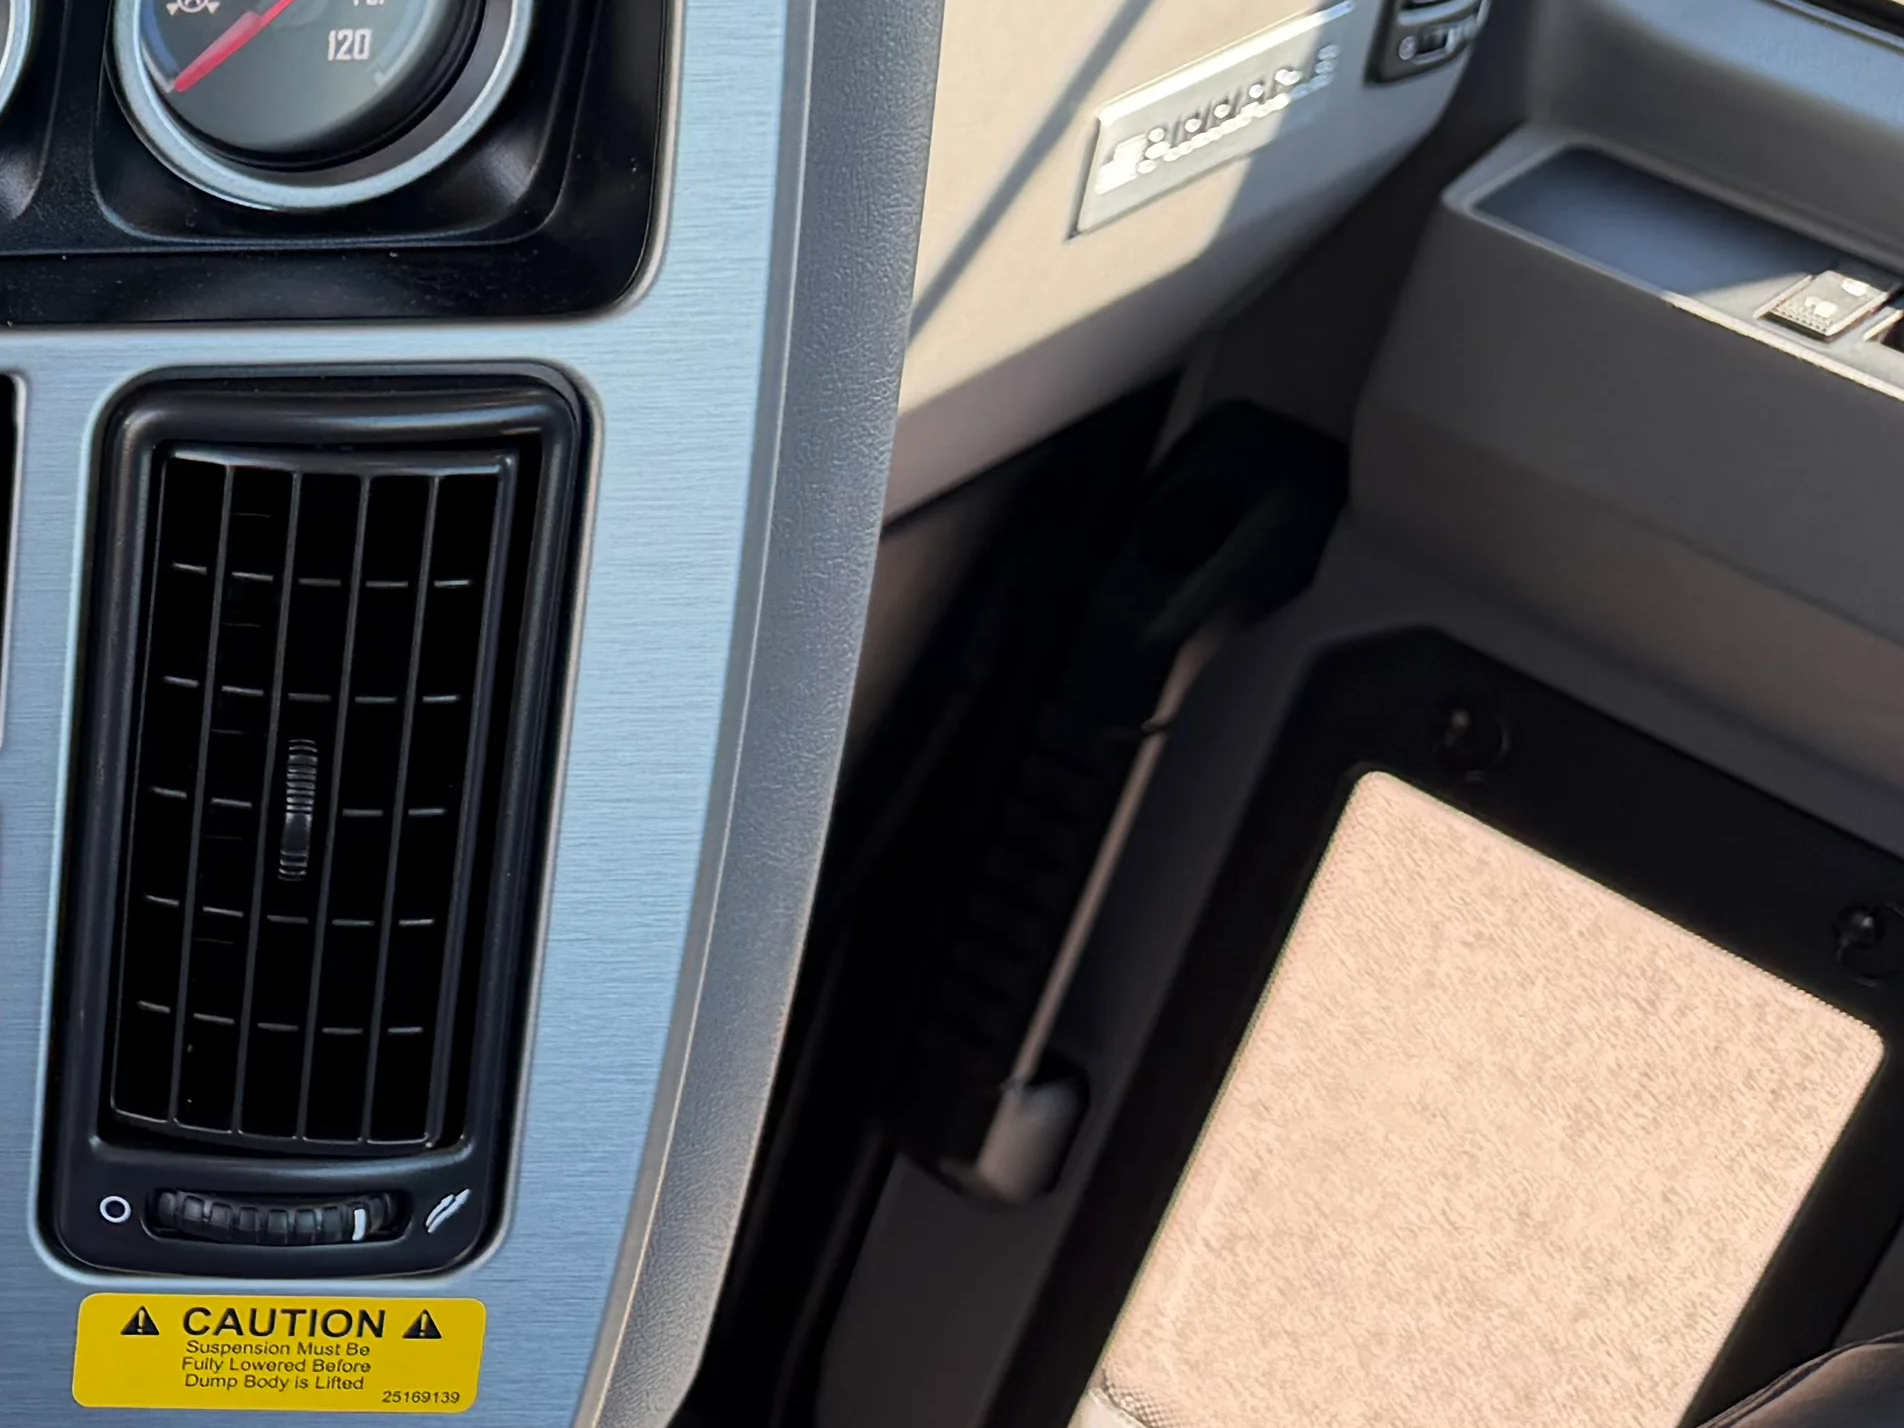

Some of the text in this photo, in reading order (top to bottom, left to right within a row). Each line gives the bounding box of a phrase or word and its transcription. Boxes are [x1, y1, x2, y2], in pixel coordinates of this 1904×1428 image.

[327, 28, 372, 62] 120
[183, 1306, 385, 1339] CAUTION
[186, 1340, 370, 1356] Suspension Must Be
[182, 1357, 371, 1373] Fully Lowered Before
[185, 1375, 364, 1392] Dump Body is Lifted
[382, 1391, 460, 1404] 25169139
